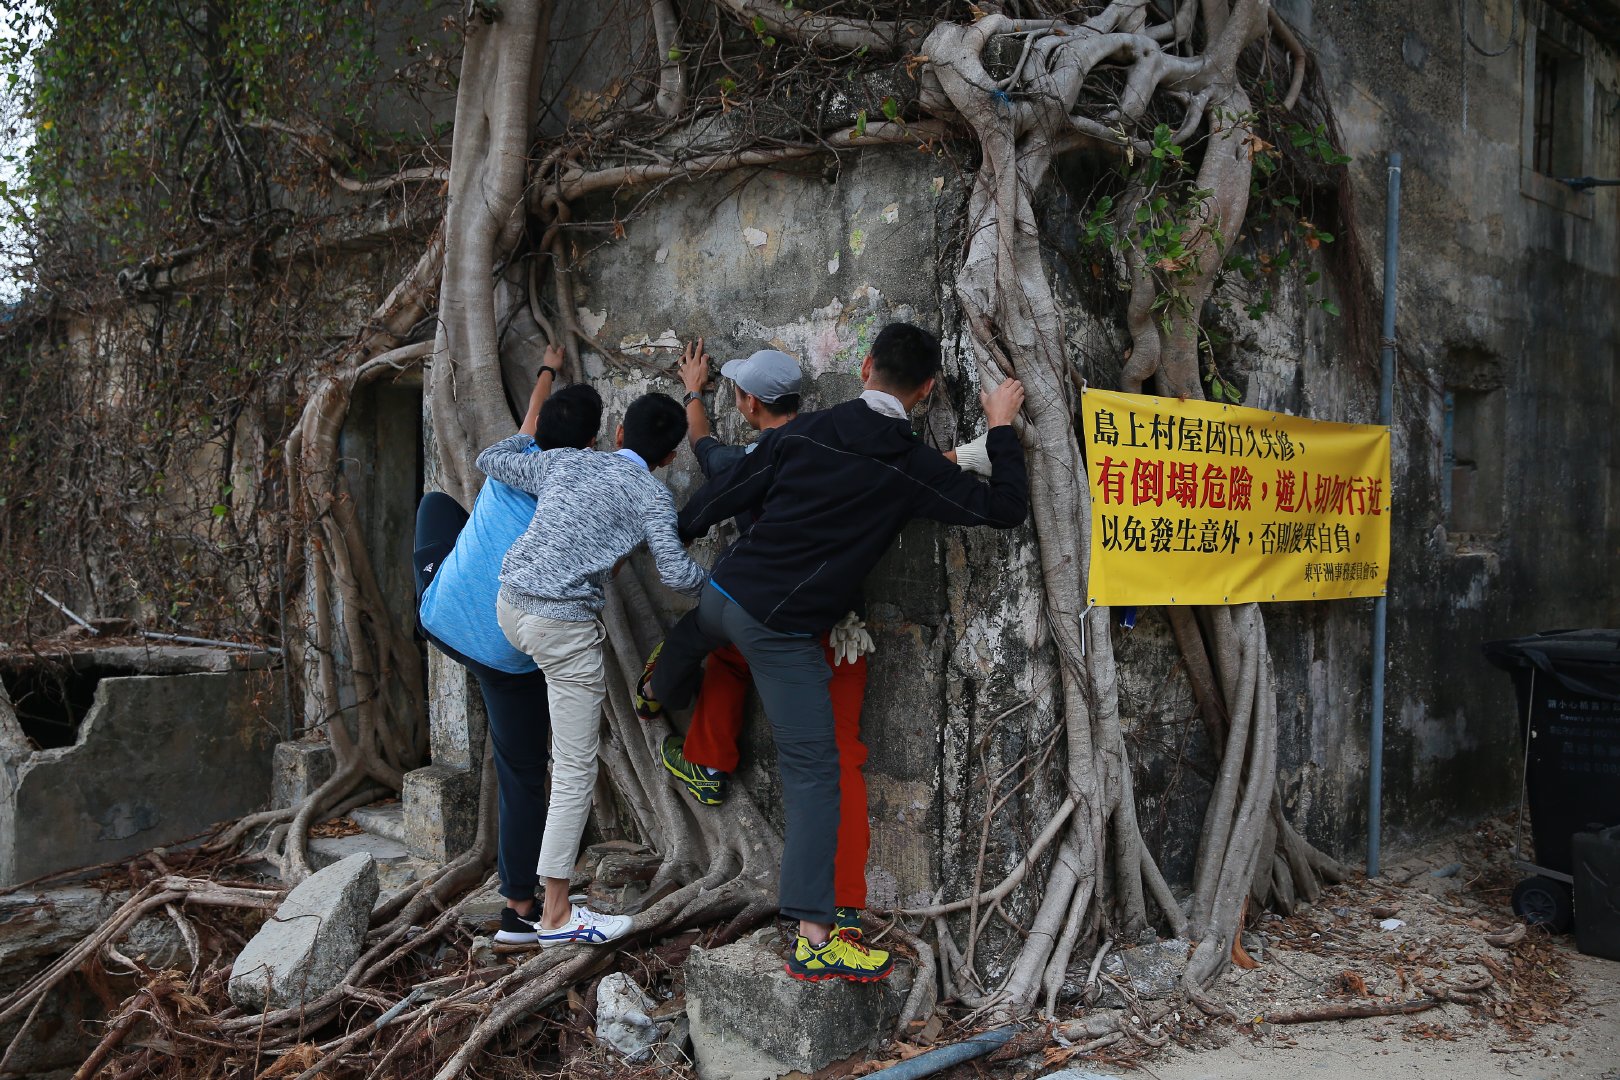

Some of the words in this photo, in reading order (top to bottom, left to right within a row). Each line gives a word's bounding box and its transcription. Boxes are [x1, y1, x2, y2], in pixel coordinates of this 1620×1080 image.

[1101, 514, 1360, 555] 以免發生意外，否則後果自負。
